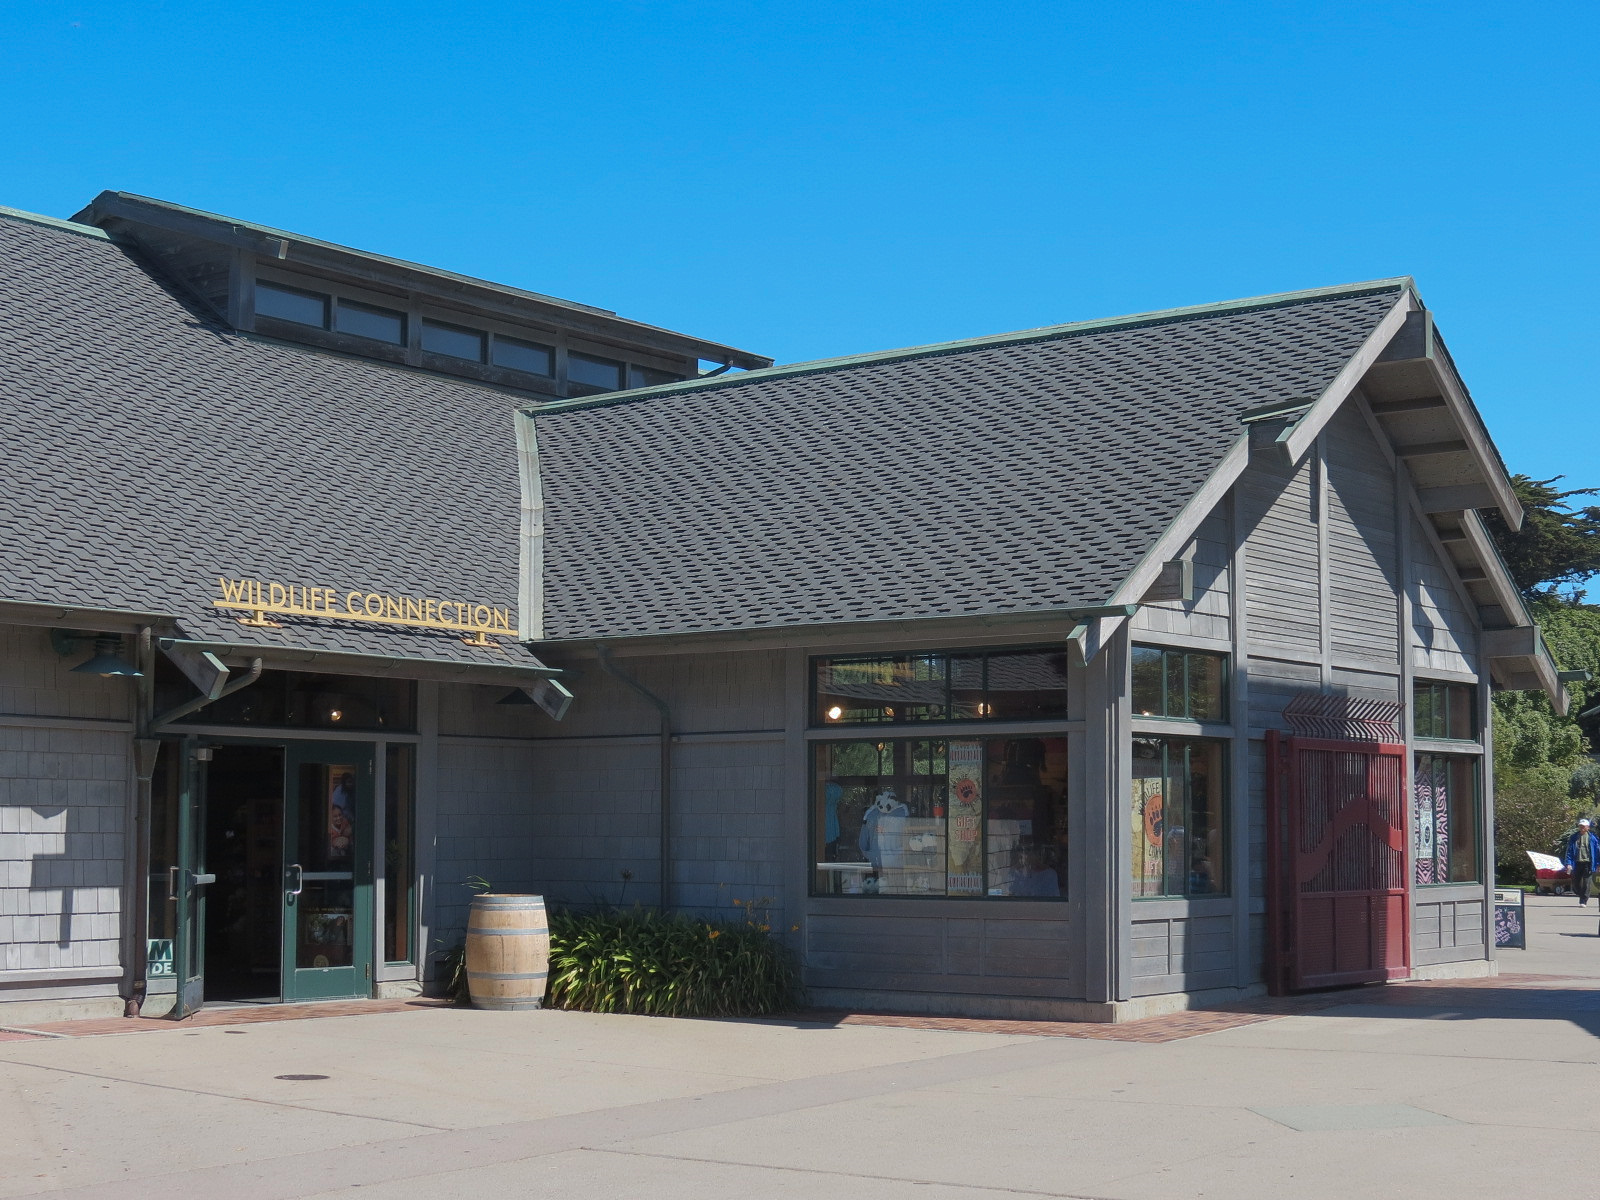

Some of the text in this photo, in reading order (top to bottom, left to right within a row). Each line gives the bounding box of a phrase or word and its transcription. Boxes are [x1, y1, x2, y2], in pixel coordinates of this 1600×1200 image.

[219, 577, 509, 630] WILDLIFE CONNECTION
[956, 816, 976, 828] GIFT
[954, 828, 978, 842] SHOP
